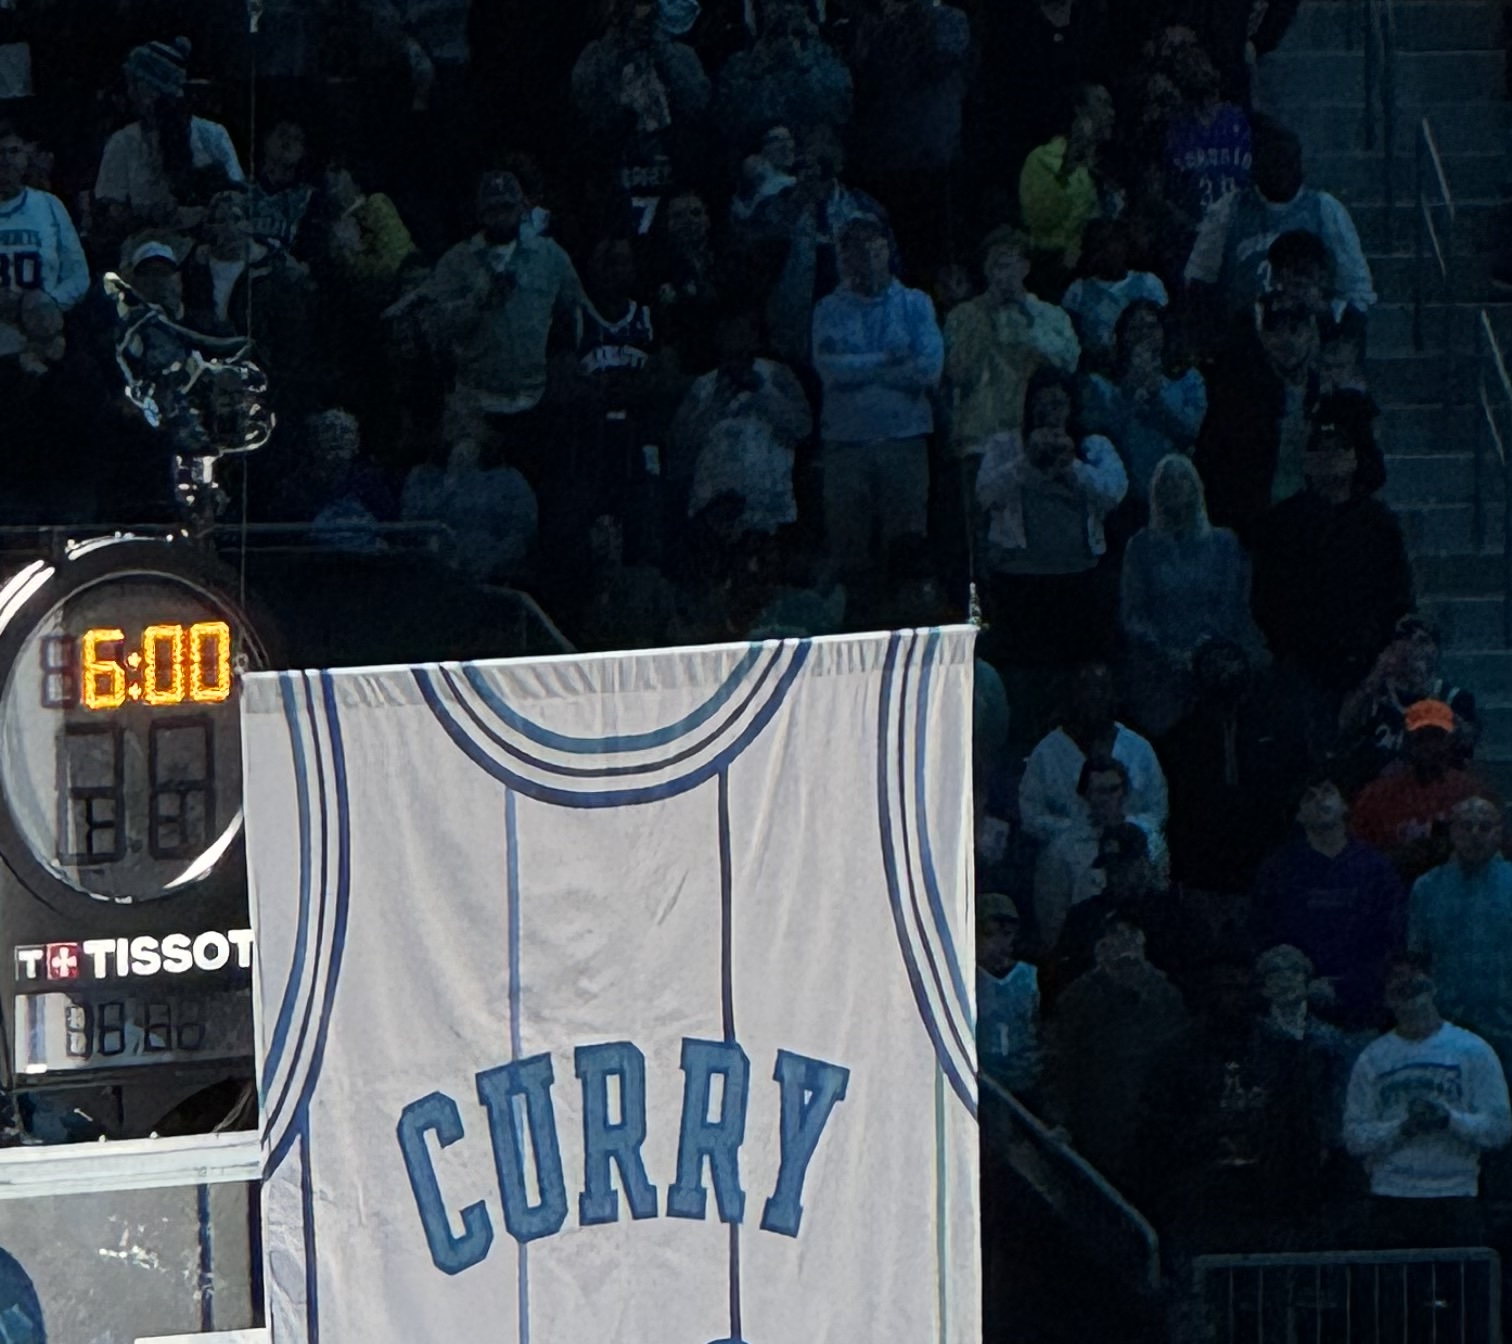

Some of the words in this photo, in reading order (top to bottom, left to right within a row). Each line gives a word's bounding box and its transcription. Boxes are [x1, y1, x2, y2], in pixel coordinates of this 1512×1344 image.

[83, 621, 231, 710] 6:00
[83, 929, 254, 979] TISSOT
[397, 1037, 850, 1275] CURRY
